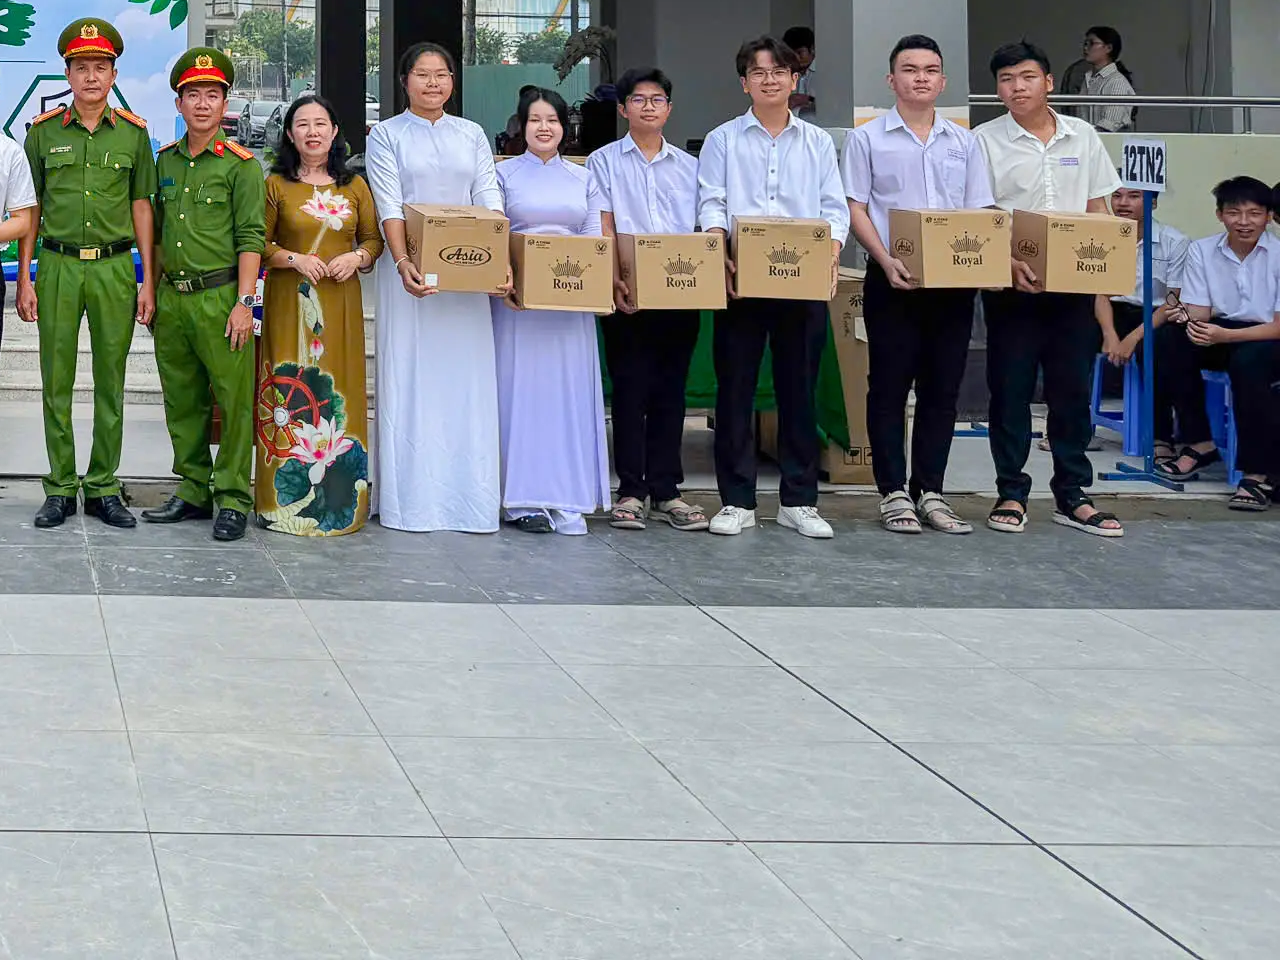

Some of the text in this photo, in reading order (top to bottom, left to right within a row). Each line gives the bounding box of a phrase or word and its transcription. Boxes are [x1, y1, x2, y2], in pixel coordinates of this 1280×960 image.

[1124, 145, 1164, 184] 12TN2
[446, 248, 484, 262] Asia
[952, 254, 982, 268] Royal
[768, 266, 800, 279] Royal
[1076, 260, 1106, 274] Royal
[553, 278, 583, 292] Royal
[666, 277, 696, 290] Royal
